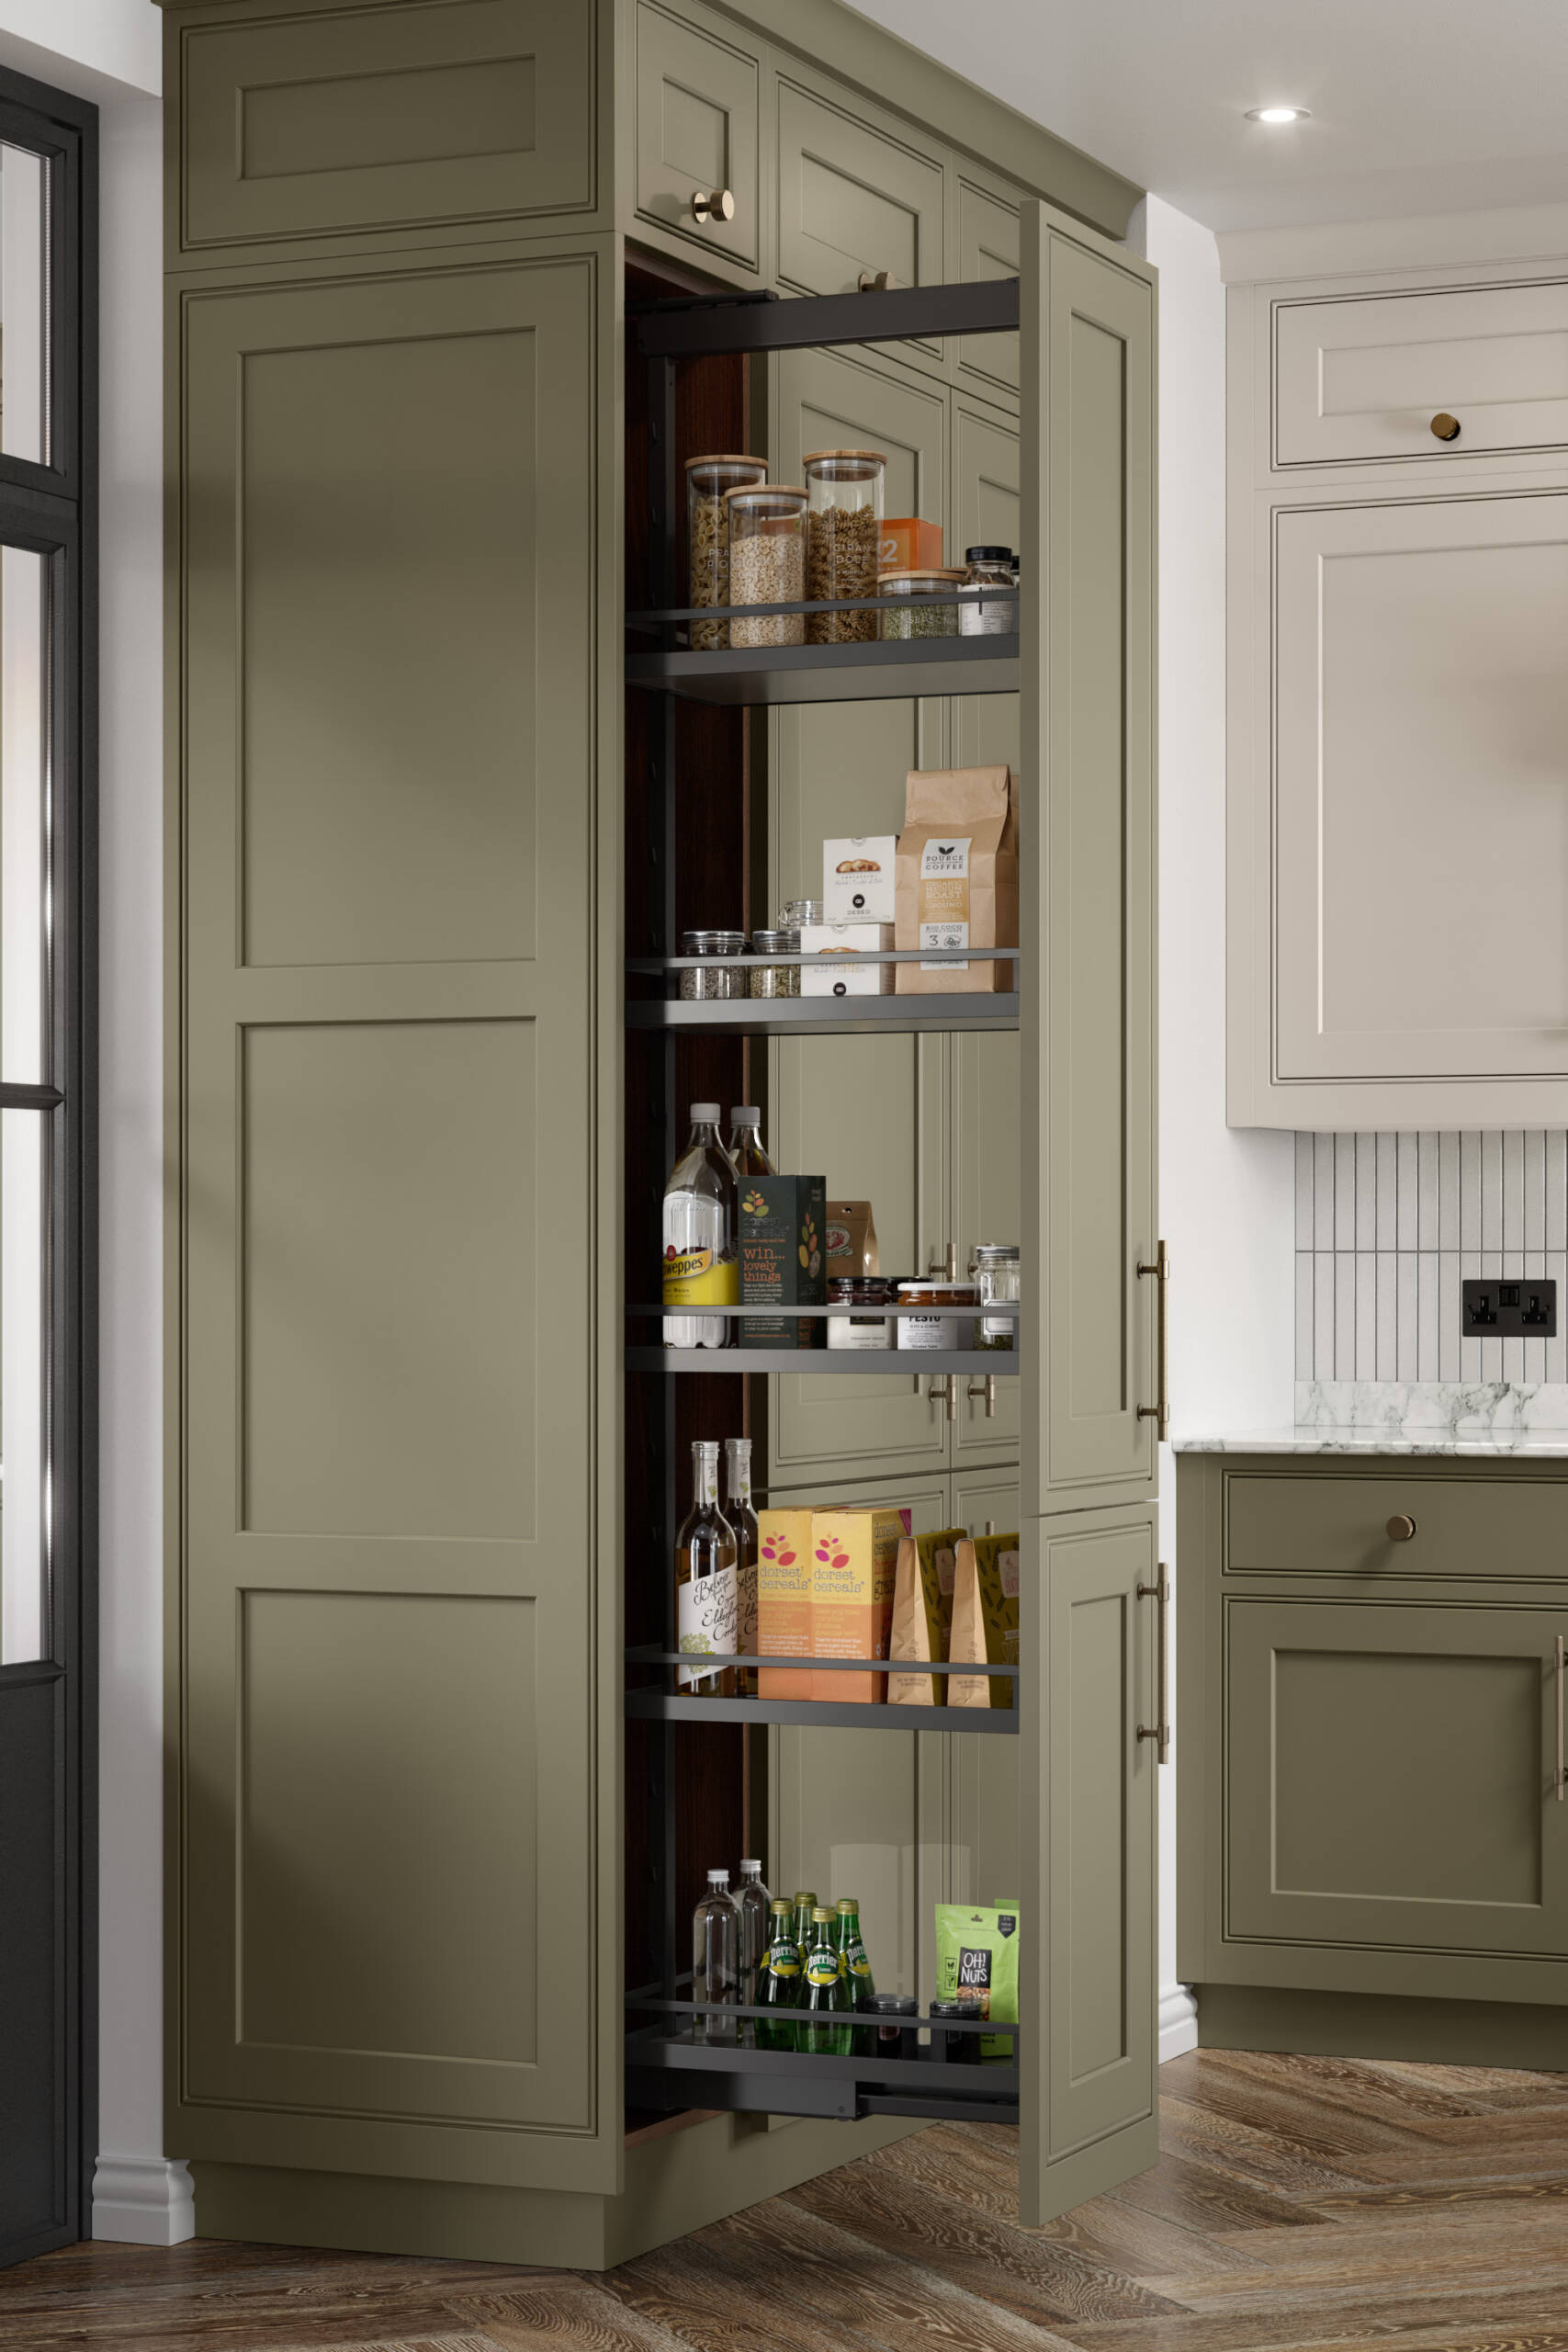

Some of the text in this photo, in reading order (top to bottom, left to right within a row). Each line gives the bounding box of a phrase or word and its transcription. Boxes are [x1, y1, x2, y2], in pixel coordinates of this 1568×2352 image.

[929, 934, 939, 946] 3
[743, 1261, 778, 1272] lovely
[743, 1272, 782, 1284] things
[760, 1566, 802, 1577] dorset
[814, 1568, 855, 1580] dorset
[771, 1946, 799, 1962] Perrier
[808, 1952, 837, 1968] Perrier
[964, 1952, 987, 1968] OH!
[961, 1967, 987, 1983] NUTS
